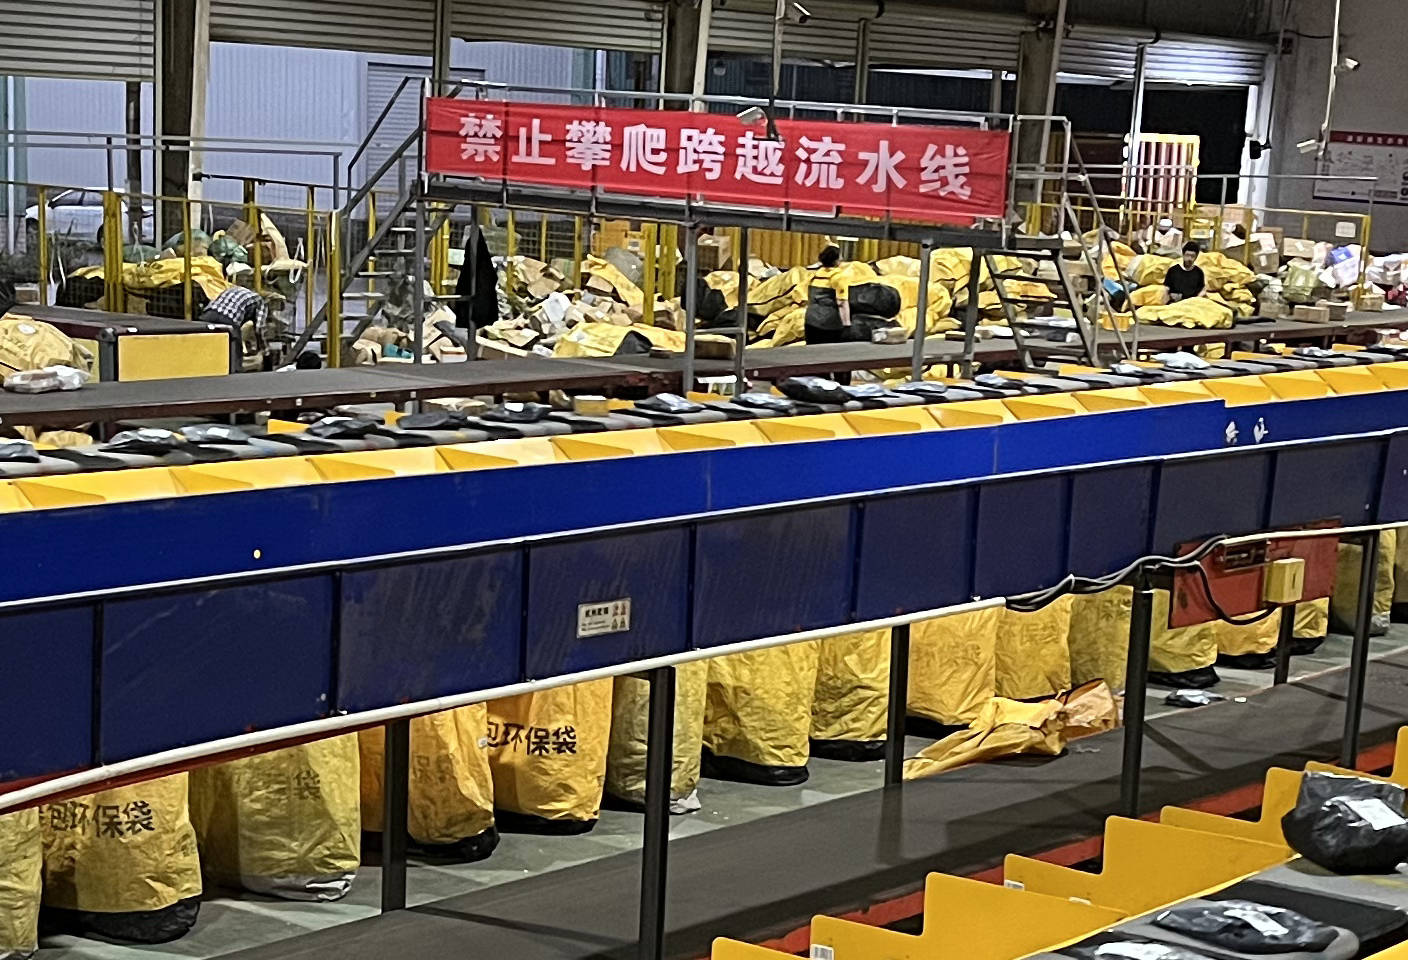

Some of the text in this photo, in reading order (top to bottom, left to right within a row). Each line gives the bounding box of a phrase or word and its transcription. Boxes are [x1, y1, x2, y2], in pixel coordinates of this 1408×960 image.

[459, 112, 972, 200] 禁止攀爬跨越流水线
